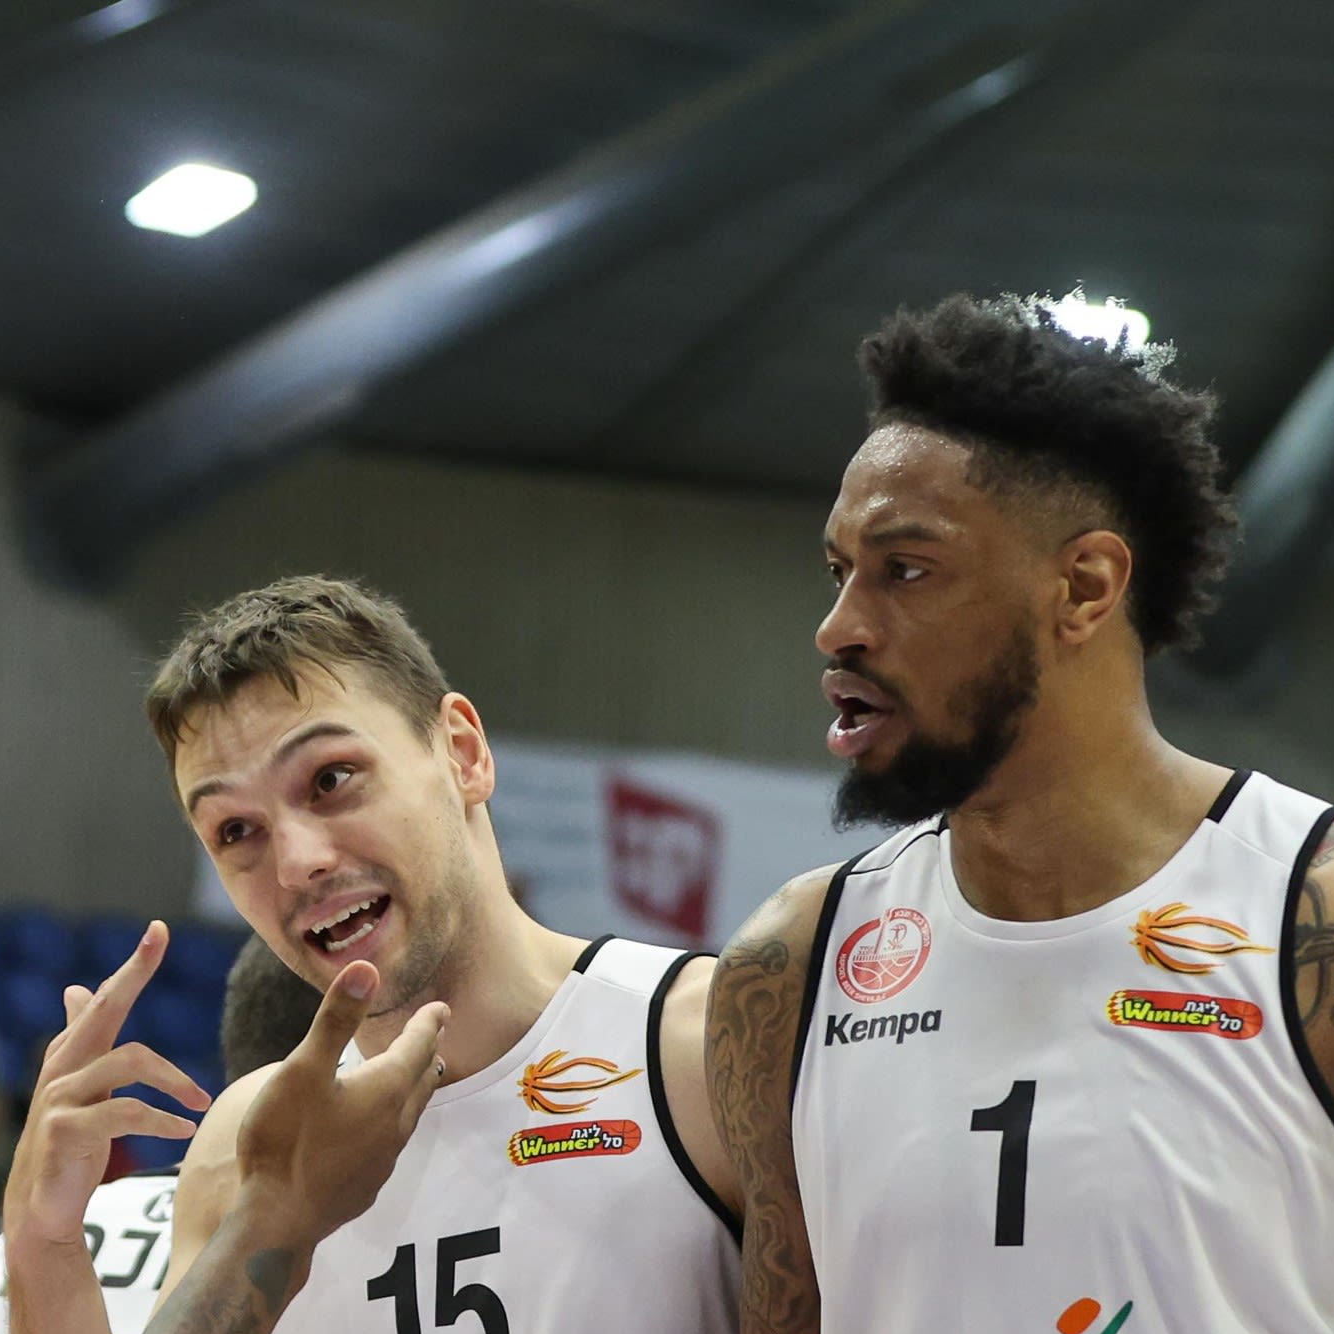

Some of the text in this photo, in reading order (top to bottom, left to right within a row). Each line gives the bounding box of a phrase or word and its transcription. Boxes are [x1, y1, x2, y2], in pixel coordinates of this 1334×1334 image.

[824, 1009, 942, 1047] Kempa
[1220, 1013, 1243, 1031] סל
[602, 1133, 623, 1149] סל
[970, 1080, 1038, 1247] 1
